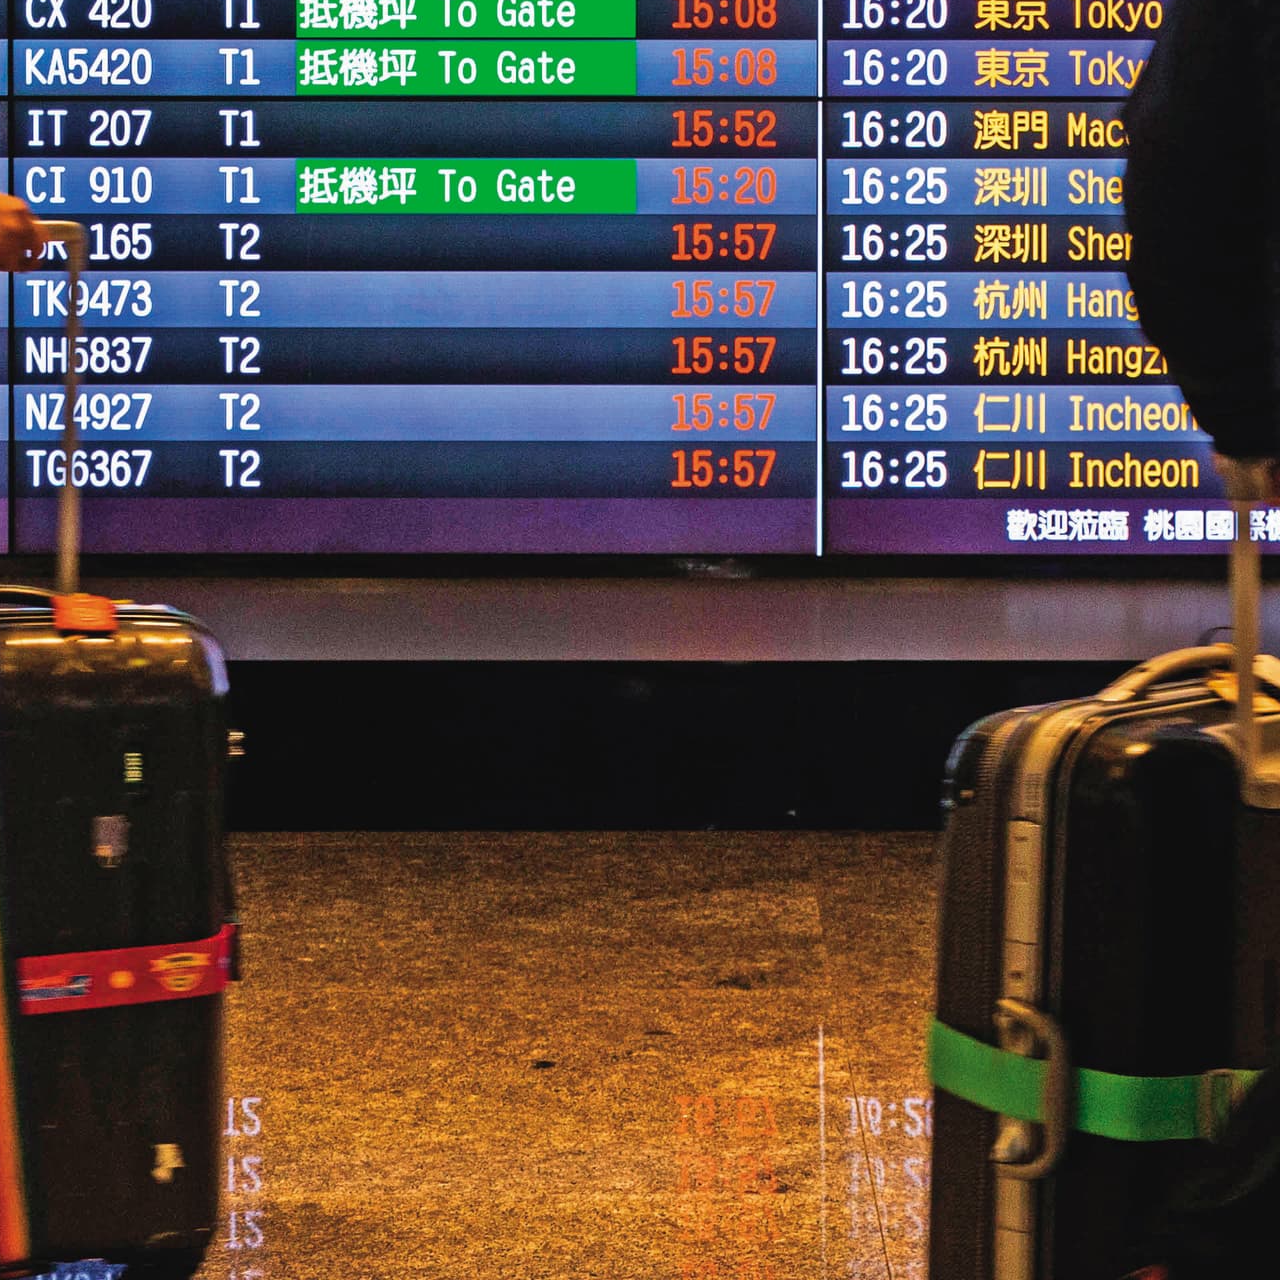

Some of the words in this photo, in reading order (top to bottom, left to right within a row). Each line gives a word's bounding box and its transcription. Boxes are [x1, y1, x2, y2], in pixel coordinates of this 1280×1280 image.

[26, 449, 153, 487] TG6367
[671, 449, 777, 488] 15:57
[973, 449, 1046, 490] 仁川
[1069, 451, 1199, 488] Incheon
[1006, 508, 1130, 542] 歡迎蒞臨
